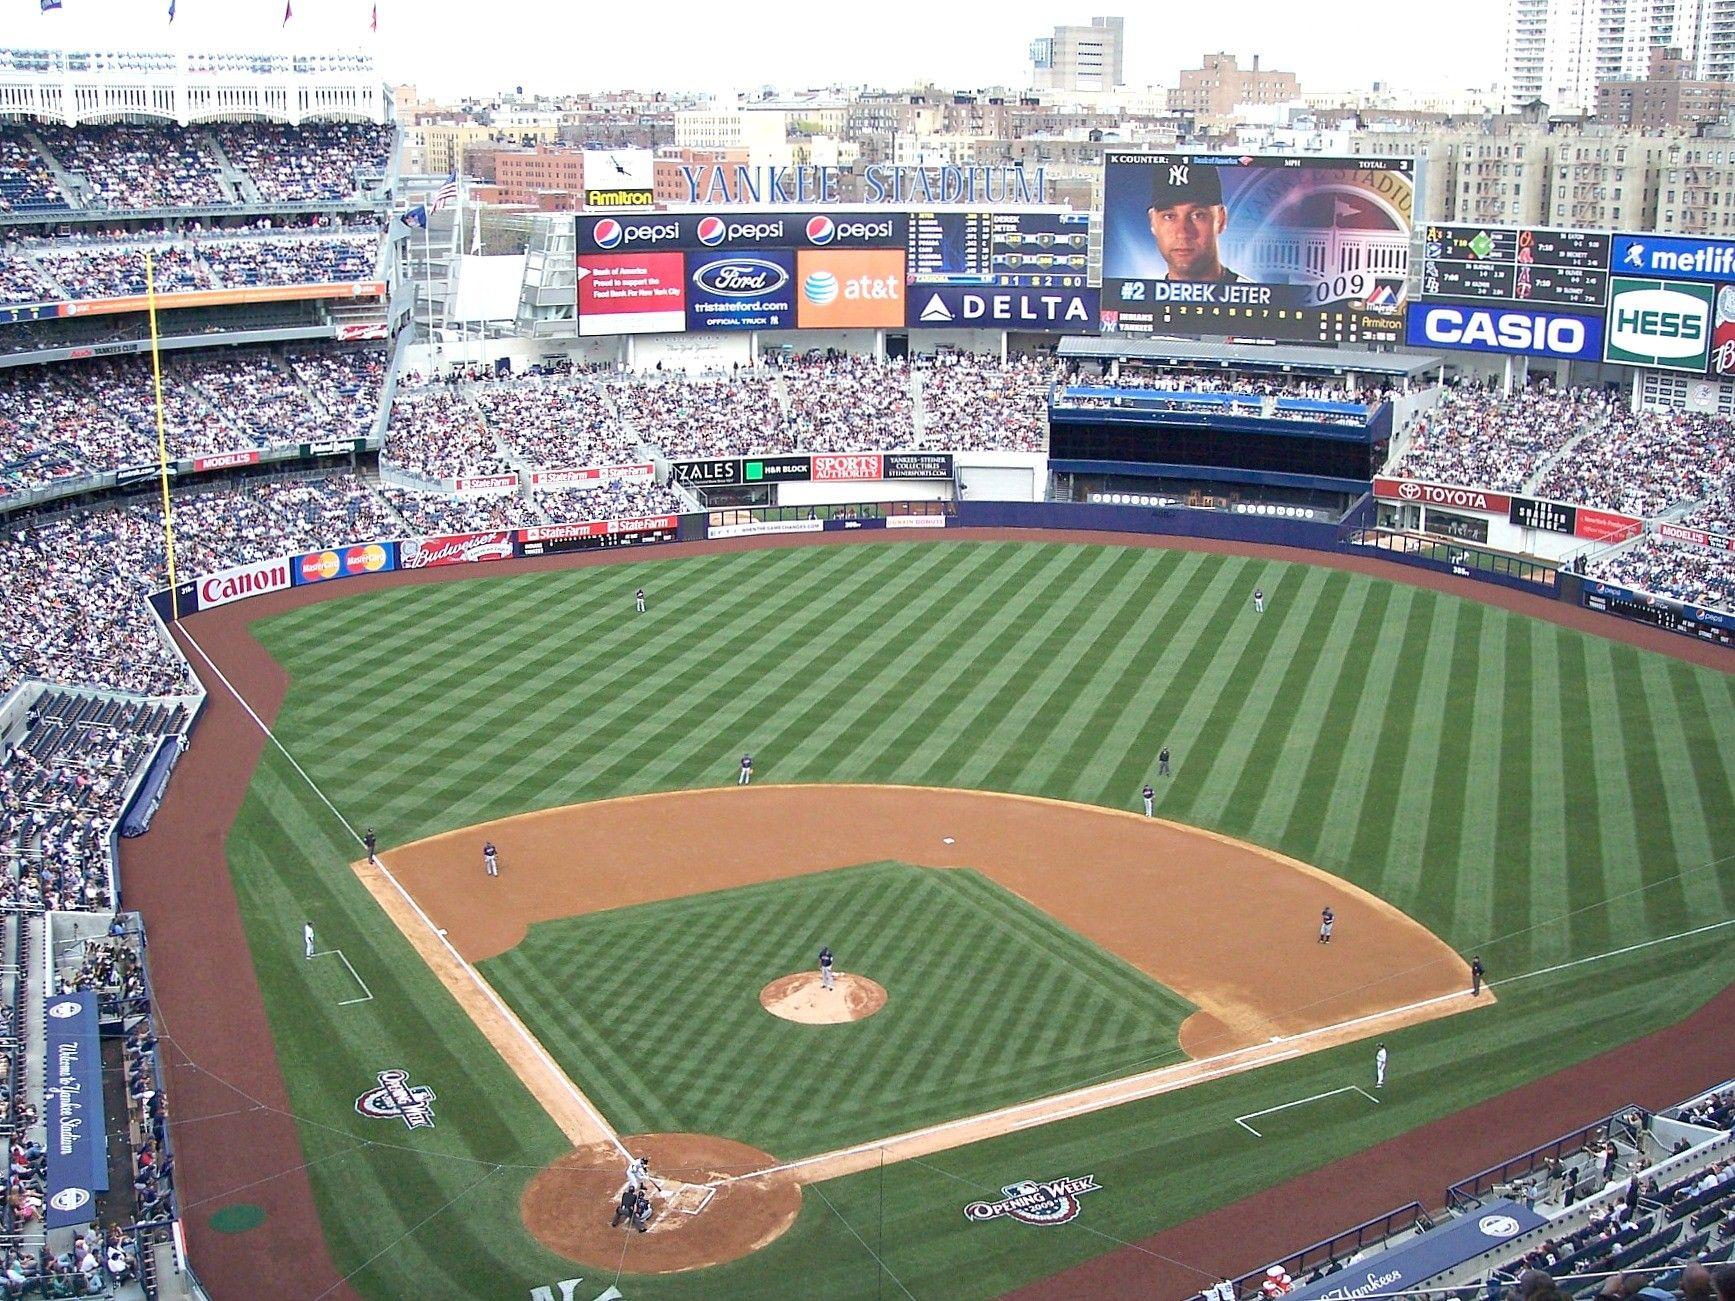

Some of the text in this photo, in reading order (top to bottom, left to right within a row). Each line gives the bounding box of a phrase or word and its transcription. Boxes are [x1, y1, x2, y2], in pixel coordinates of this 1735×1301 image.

[1111, 155, 1118, 164] K
[1119, 155, 1169, 165] COUNTER:
[1285, 159, 1301, 167] MPH
[682, 165, 1049, 205] YANKEE STADIUM
[590, 191, 653, 205] Armitron
[625, 221, 680, 243] pepsi
[729, 220, 784, 241] pepsi
[837, 220, 892, 240] pepsi
[1651, 246, 1735, 274] metlif
[714, 266, 766, 289] Ford
[844, 274, 898, 300] at&t
[1120, 281, 1271, 305] #2 DEREK JETER
[695, 301, 789, 313] tristateford.com
[963, 295, 1089, 321] DELTA
[707, 317, 767, 326] OFFICIAL TRUCK
[1362, 316, 1402, 329] Armitron
[1617, 308, 1702, 340] HESS
[1425, 308, 1585, 354] CASIO
[203, 453, 251, 469] MODELL'S
[765, 465, 808, 474] H&R BLOCK
[816, 457, 878, 471] SPORTS
[679, 462, 734, 480] ZALES
[816, 469, 878, 479] AUTHORITY
[1424, 486, 1487, 509] TOYOTA
[540, 526, 589, 539] State Farm
[620, 518, 668, 532] State Farm
[1662, 526, 1704, 543] MODELL'S
[407, 532, 497, 568] Budweiser
[302, 558, 339, 573] MasterCard
[347, 552, 386, 566] MasterCard
[202, 566, 286, 603] Canon
[1605, 587, 1621, 597] pepsi
[1705, 613, 1723, 625] pepsi
[59, 1042, 78, 1076] Welcome
[60, 1076, 76, 1086] to
[49, 1083, 81, 1118] Yankee
[60, 1118, 82, 1155] Stadium
[968, 1179, 1093, 1219] OPENING WEEK
[1028, 1200, 1055, 1213] 2009
